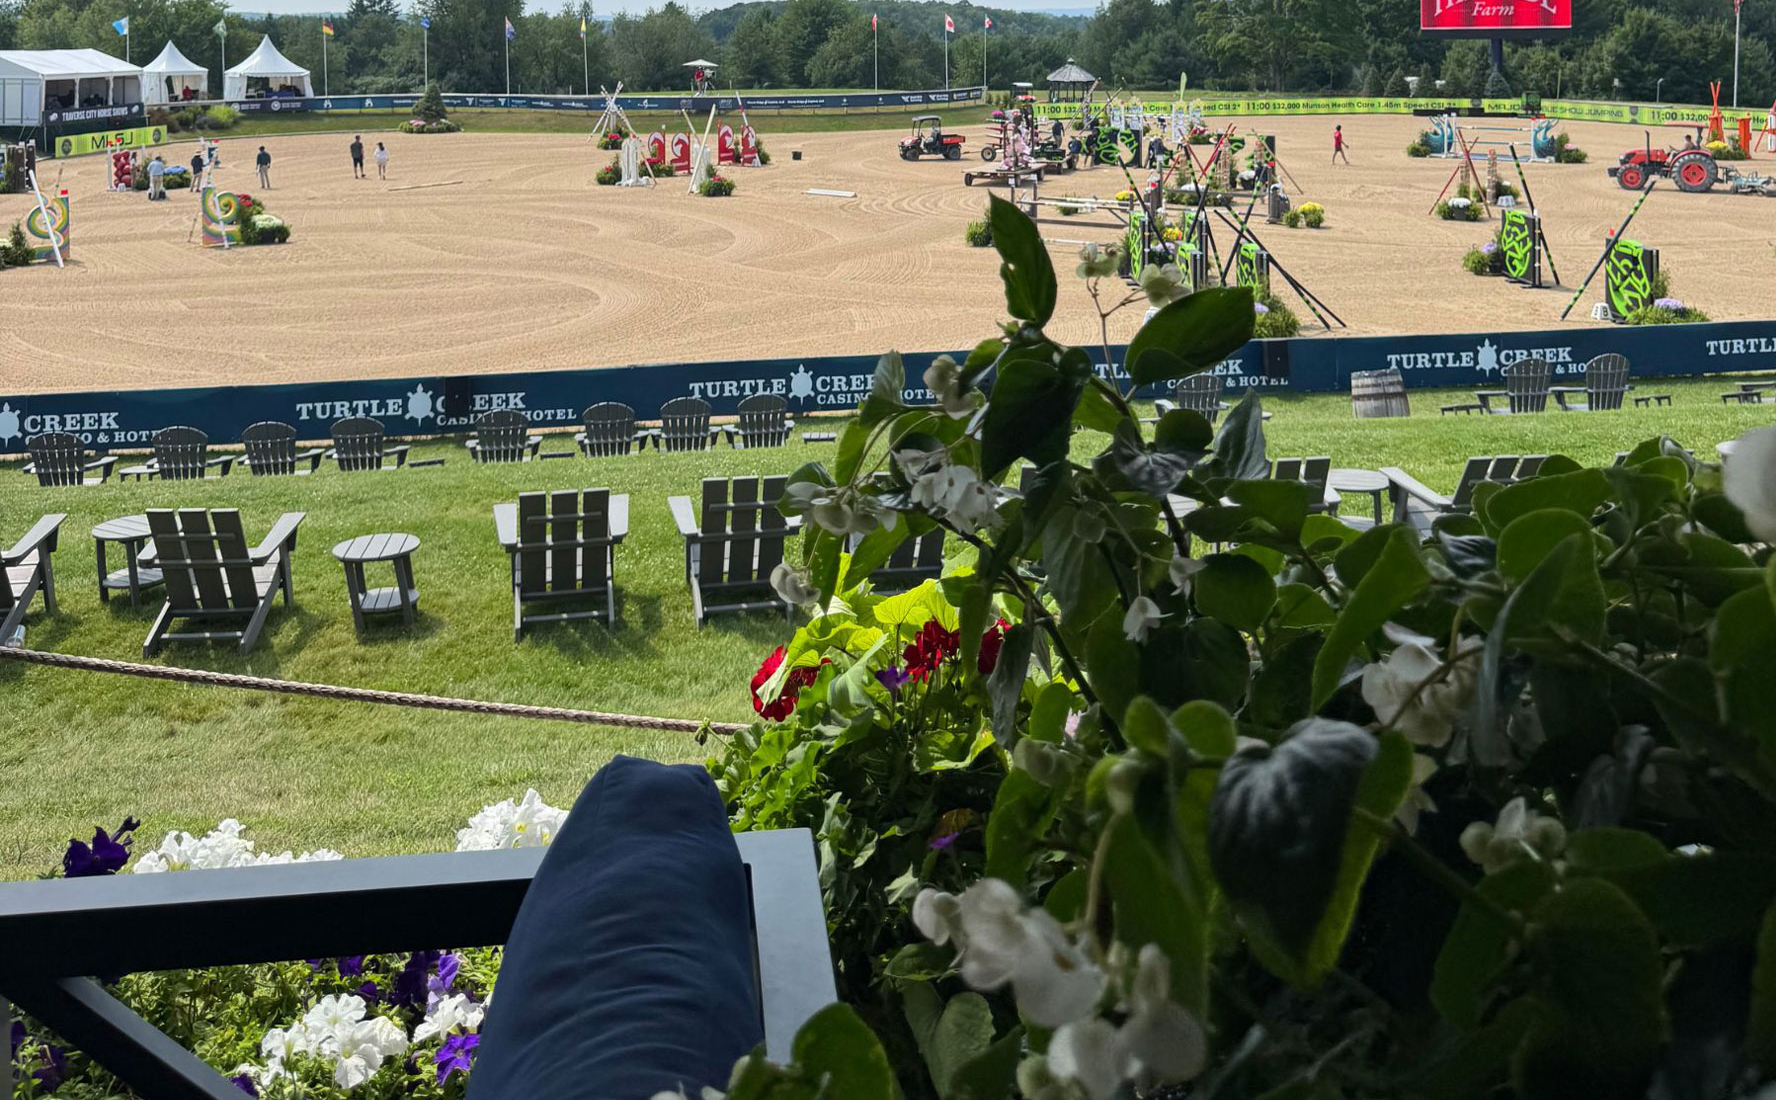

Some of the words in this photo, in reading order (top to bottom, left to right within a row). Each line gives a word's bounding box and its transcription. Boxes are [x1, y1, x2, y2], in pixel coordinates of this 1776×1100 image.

[1472, 1, 1515, 17] Farm
[1037, 105, 1061, 114] 11:00
[1149, 104, 1168, 112] Care
[1218, 103, 1231, 111] CSI
[1246, 102, 1271, 111] 11:00
[1272, 102, 1301, 111] $32,000
[1403, 102, 1429, 110] Speed
[62, 110, 86, 122] TRAVERSE
[86, 110, 97, 119] CITY
[97, 108, 112, 118] HORSE
[112, 106, 128, 117] SHOWS
[1651, 111, 1678, 121] 11:00
[1681, 113, 1709, 122] $32,00
[1387, 352, 1474, 370] TURTLE
[1555, 364, 1566, 375] &
[689, 378, 787, 399] TURTLE
[815, 374, 876, 393] CREE
[1225, 377, 1236, 388] &
[1238, 376, 1289, 387] HOTEL
[900, 388, 936, 400] OTE
[296, 398, 403, 420] TURTLE
[435, 392, 527, 413] CEEK
[24, 411, 120, 433] CREEK
[97, 431, 111, 444] &
[113, 430, 160, 443] HOT
